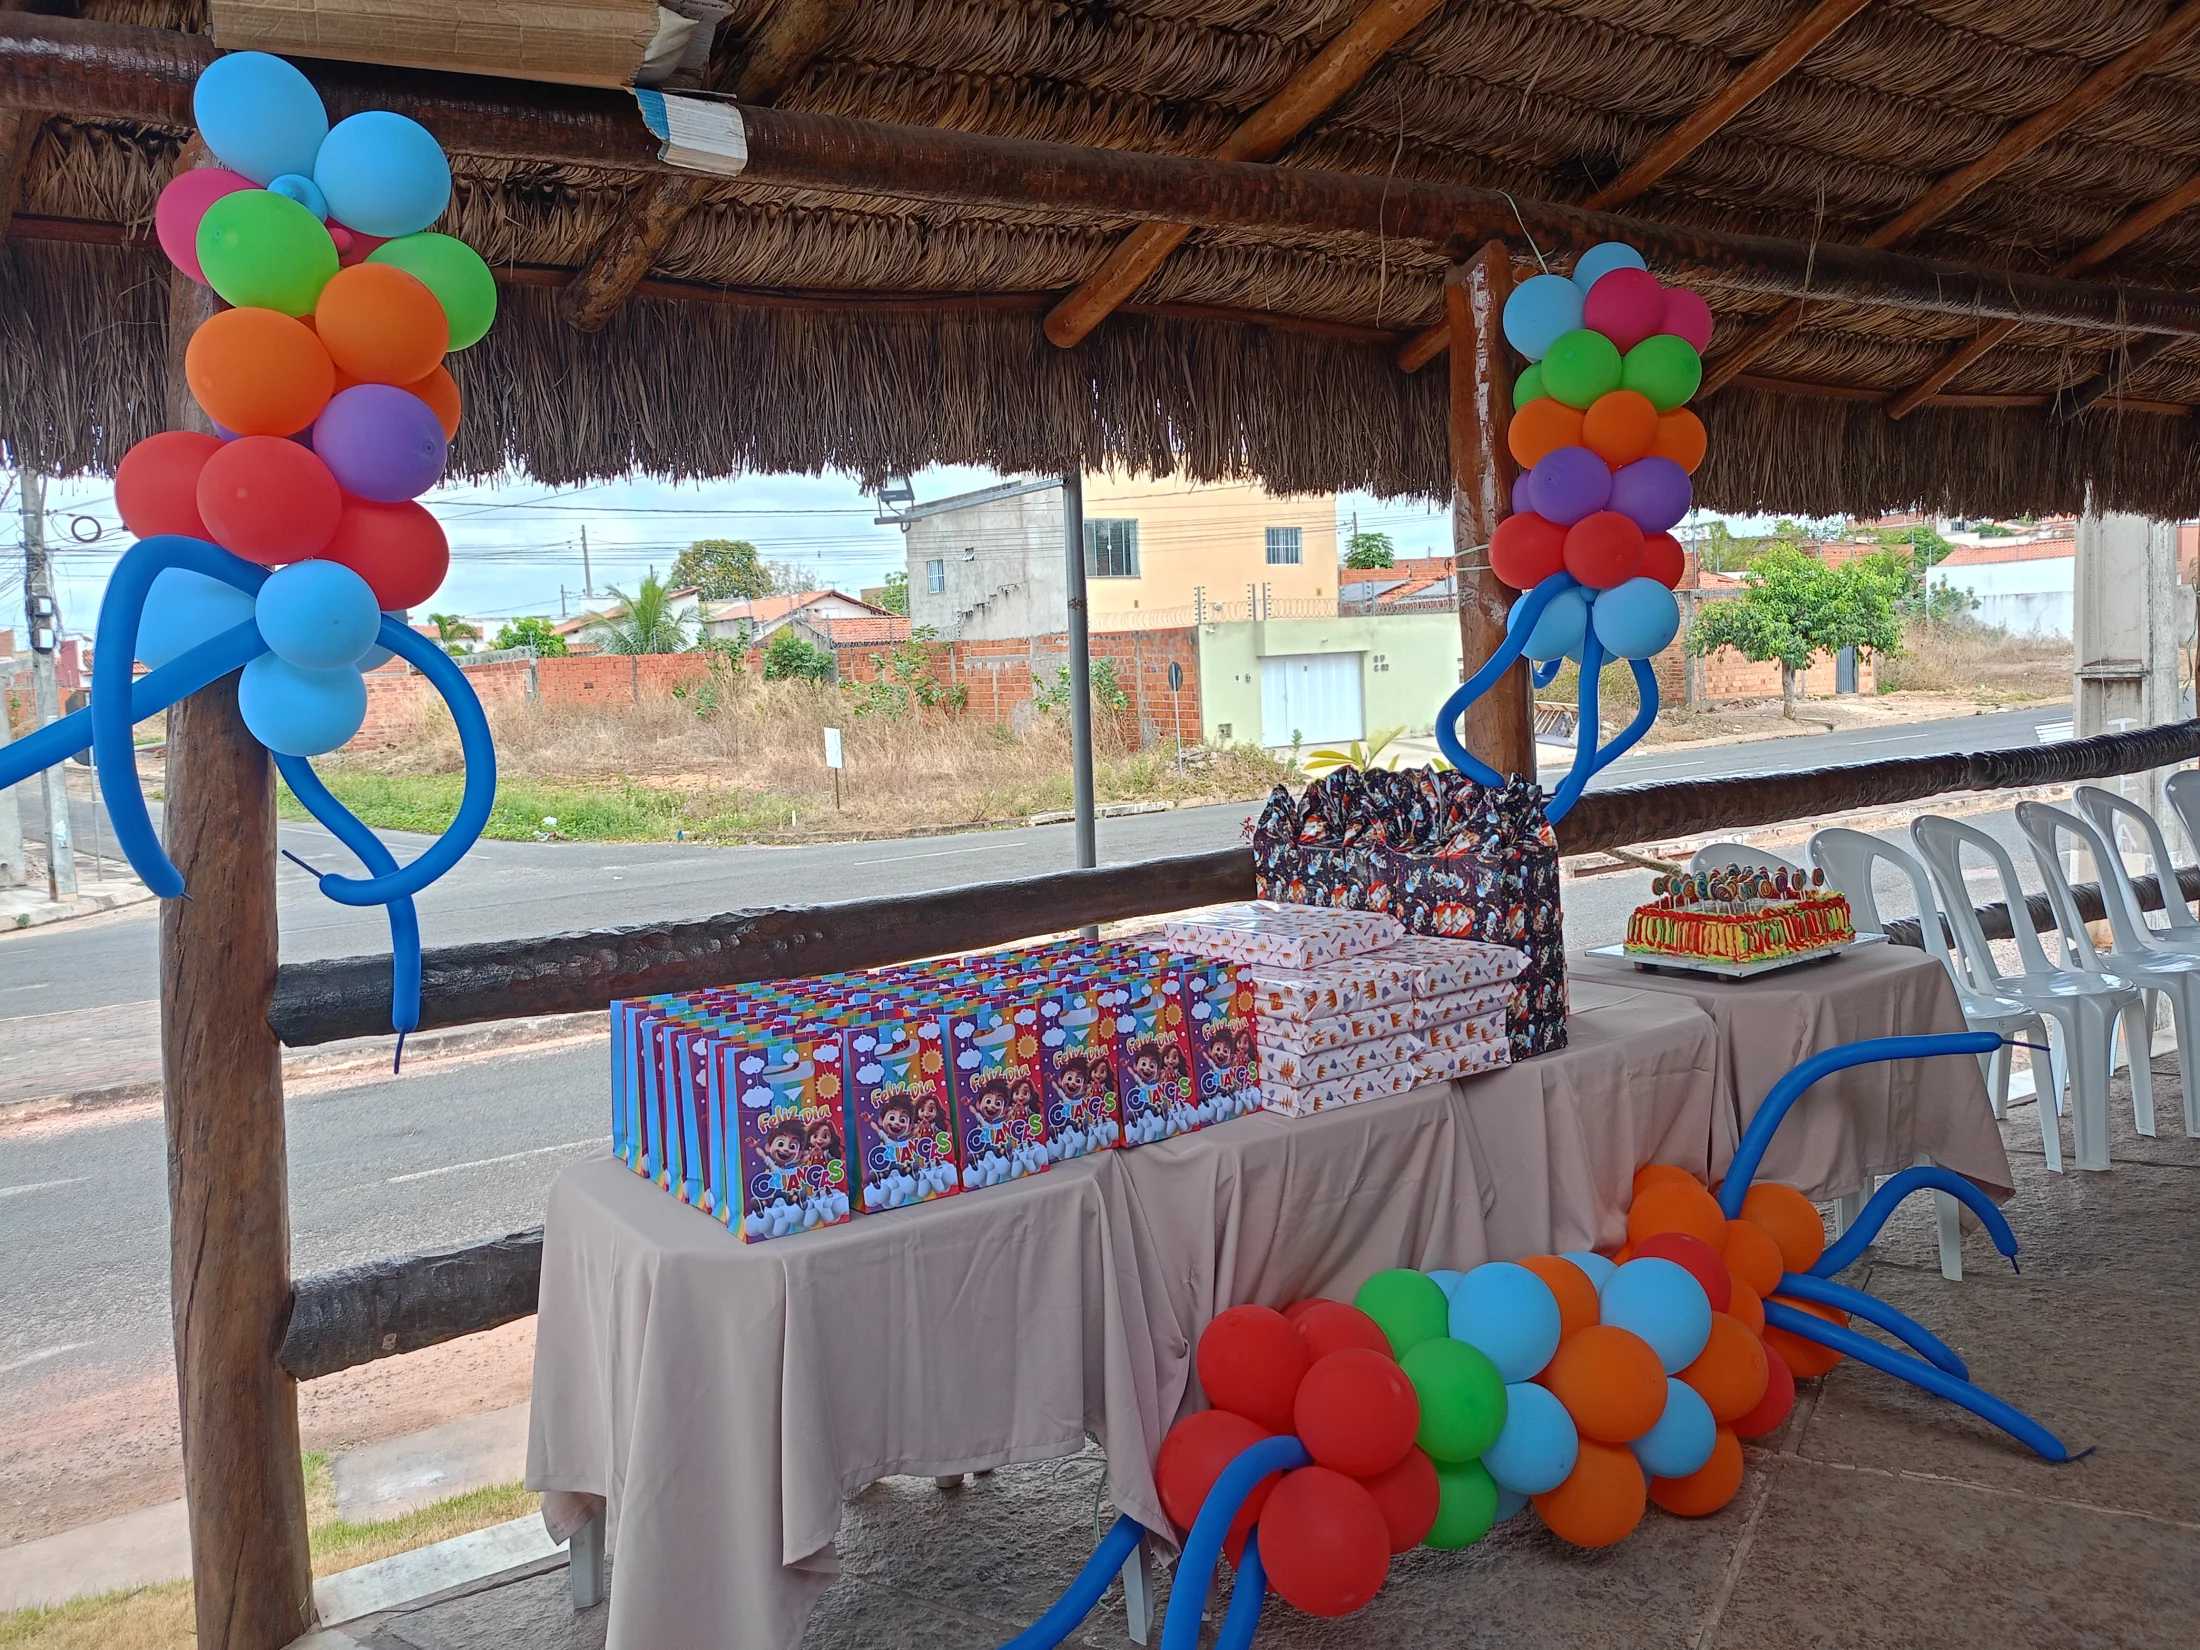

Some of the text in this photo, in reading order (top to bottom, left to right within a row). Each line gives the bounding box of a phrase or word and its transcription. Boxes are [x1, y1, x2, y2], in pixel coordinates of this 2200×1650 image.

[871, 1080, 906, 1109] Feliz
[970, 1065, 1003, 1093] Feliz
[1126, 1076, 1192, 1112] CRIANÇAS
[1201, 1061, 1258, 1094] CRIANÇAS
[758, 1104, 800, 1135] Feliz
[1048, 1092, 1116, 1127] CRIANÇAS
[967, 1114, 1043, 1152] CRIANÇAS
[868, 1131, 951, 1171] CRIANÇAS
[751, 1160, 844, 1198] CRIANÇAS
